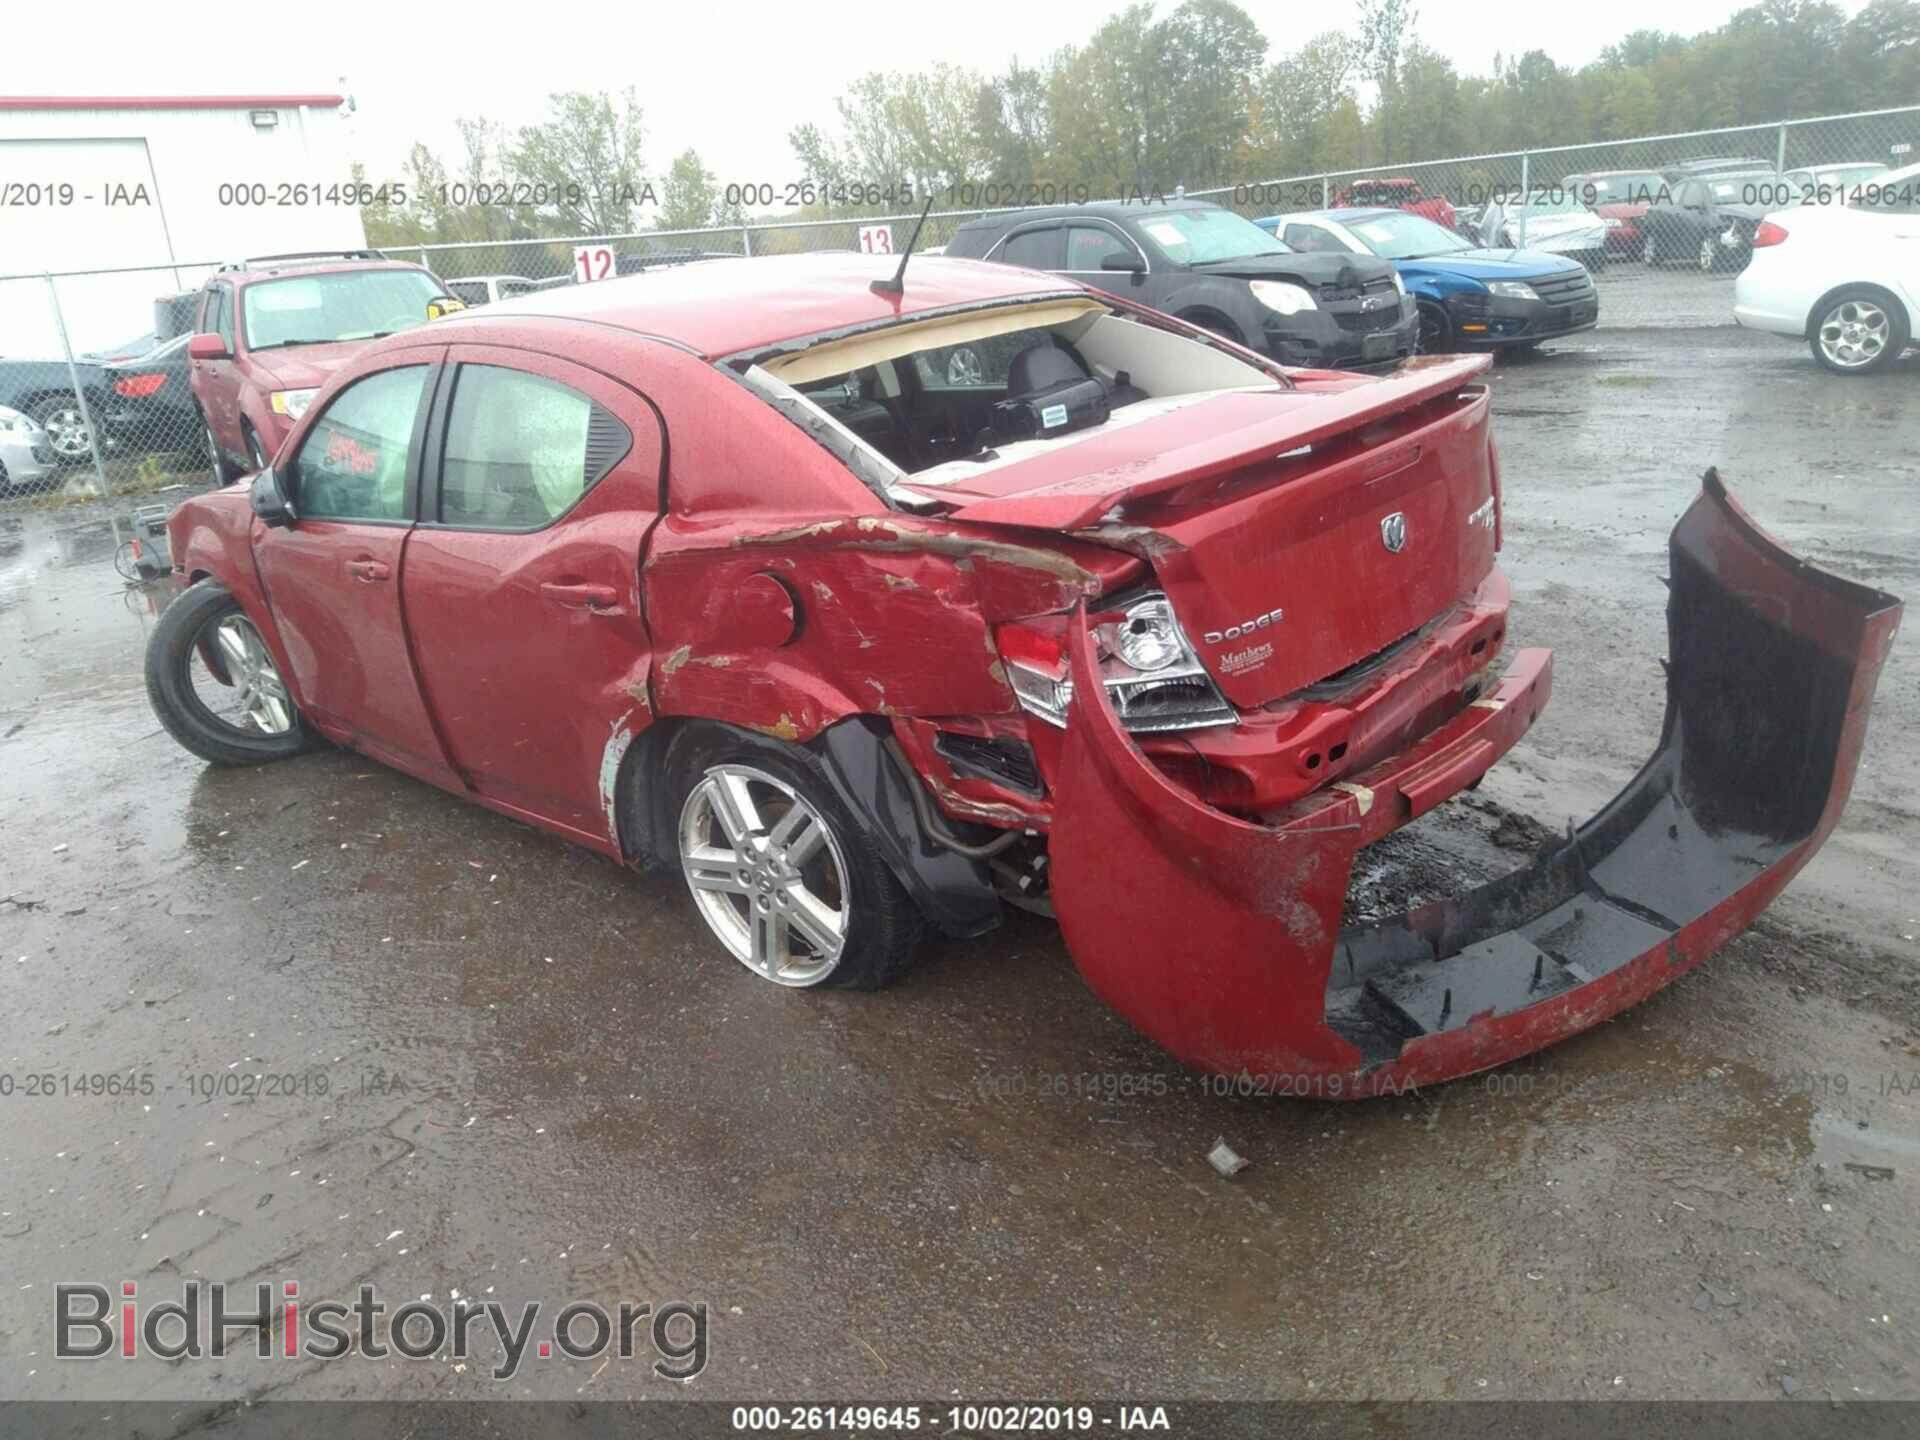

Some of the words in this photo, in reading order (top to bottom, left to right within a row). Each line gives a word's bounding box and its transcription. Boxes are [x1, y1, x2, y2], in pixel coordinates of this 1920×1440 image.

[863, 229, 891, 255] 13
[578, 249, 611, 281] 12
[1203, 607, 1284, 645] DODGE
